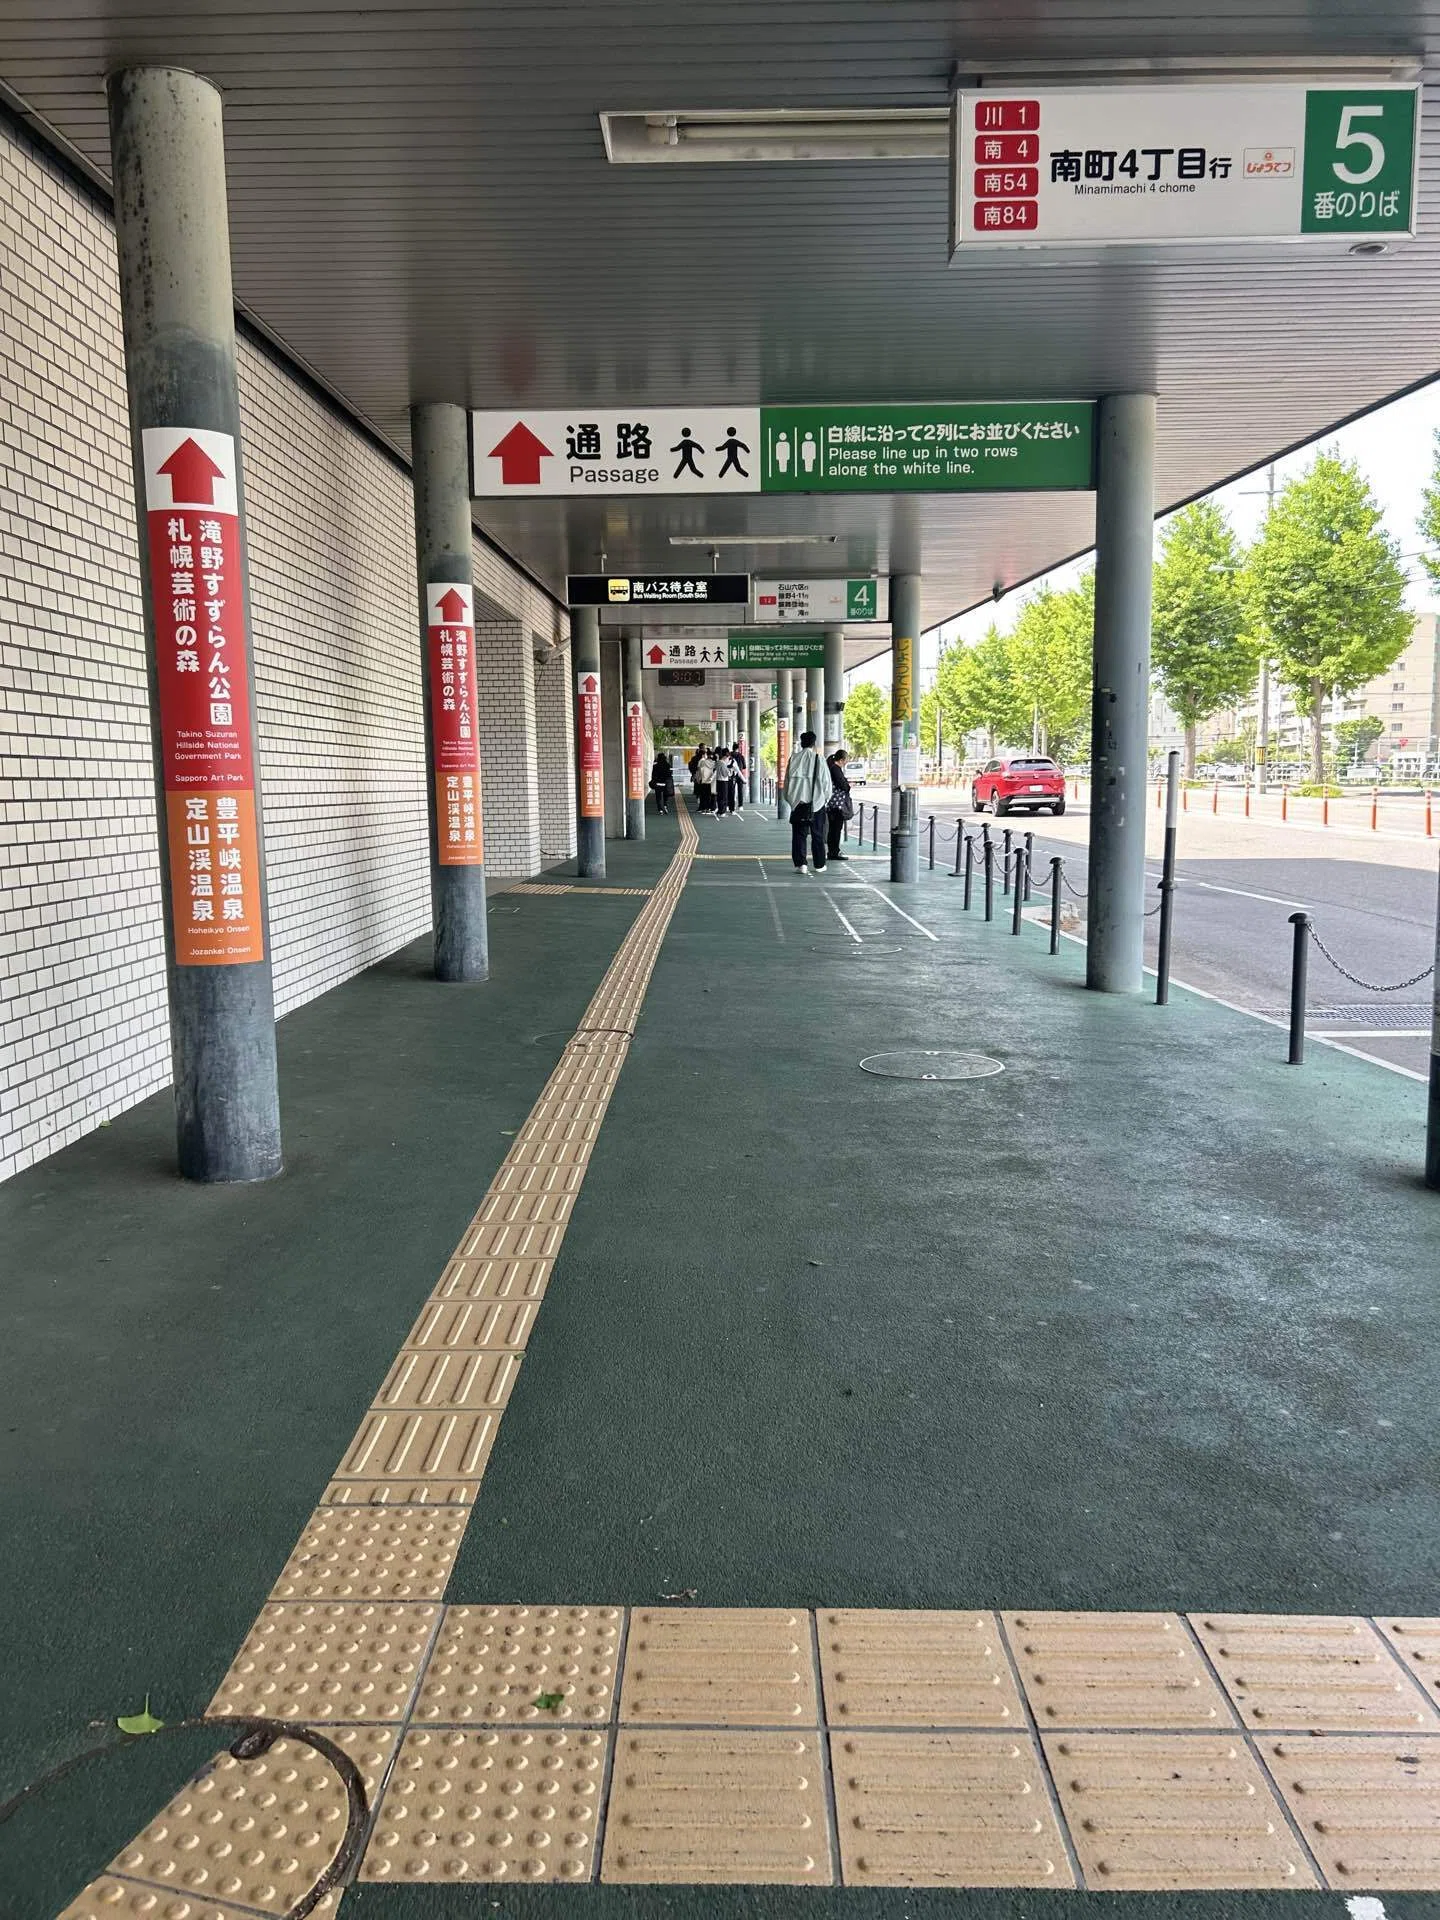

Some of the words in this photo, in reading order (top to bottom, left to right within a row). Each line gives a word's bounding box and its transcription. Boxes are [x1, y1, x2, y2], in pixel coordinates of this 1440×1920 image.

[984, 106, 1002, 126] 川
[1018, 107, 1027, 124] 1
[984, 141, 1003, 159] 南
[1017, 140, 1028, 157] 4
[1332, 105, 1385, 184] 5
[1050, 148, 1232, 182] 南町4丁目行
[1246, 162, 1291, 173] じょうてつ
[984, 173, 1028, 192] 南54
[1074, 184, 1146, 195] Minamimachi
[1149, 184, 1156, 193] 4
[1159, 183, 1196, 193] chome
[1314, 190, 1400, 219] 番のりば
[984, 206, 1027, 225] 南84
[566, 422, 652, 460] 通路
[828, 422, 1080, 443] 白線に沿って2列にお並びください
[829, 447, 876, 460] Please
[883, 447, 907, 459] line
[912, 449, 930, 461] up
[935, 446, 948, 458] in
[954, 446, 979, 457] two
[984, 447, 1018, 457] rows
[570, 466, 659, 484] Passage
[828, 463, 867, 476] along
[873, 463, 897, 475] the
[903, 462, 941, 474] white
[946, 461, 975, 474] line.
[167, 518, 200, 672] 札幌芸術の森
[633, 581, 707, 593] 南バス待合室
[854, 584, 869, 606] 4
[199, 520, 232, 725] 滝野すずらん公園
[177, 730, 203, 738] Takino
[206, 730, 237, 738] Suzuran
[779, 720, 786, 729] 3
[176, 741, 205, 749] Hillside
[207, 741, 239, 749] National
[175, 752, 222, 760] Government
[224, 752, 241, 760] Park
[175, 774, 208, 783] Sapporo
[185, 798, 214, 921] 定山渓温泉
[215, 797, 244, 921] 豊平峡温泉
[188, 926, 224, 934] Hoheikyo
[226, 925, 250, 933] Onsen
[190, 947, 225, 955] Jozankei
[227, 946, 251, 954] Onsen
